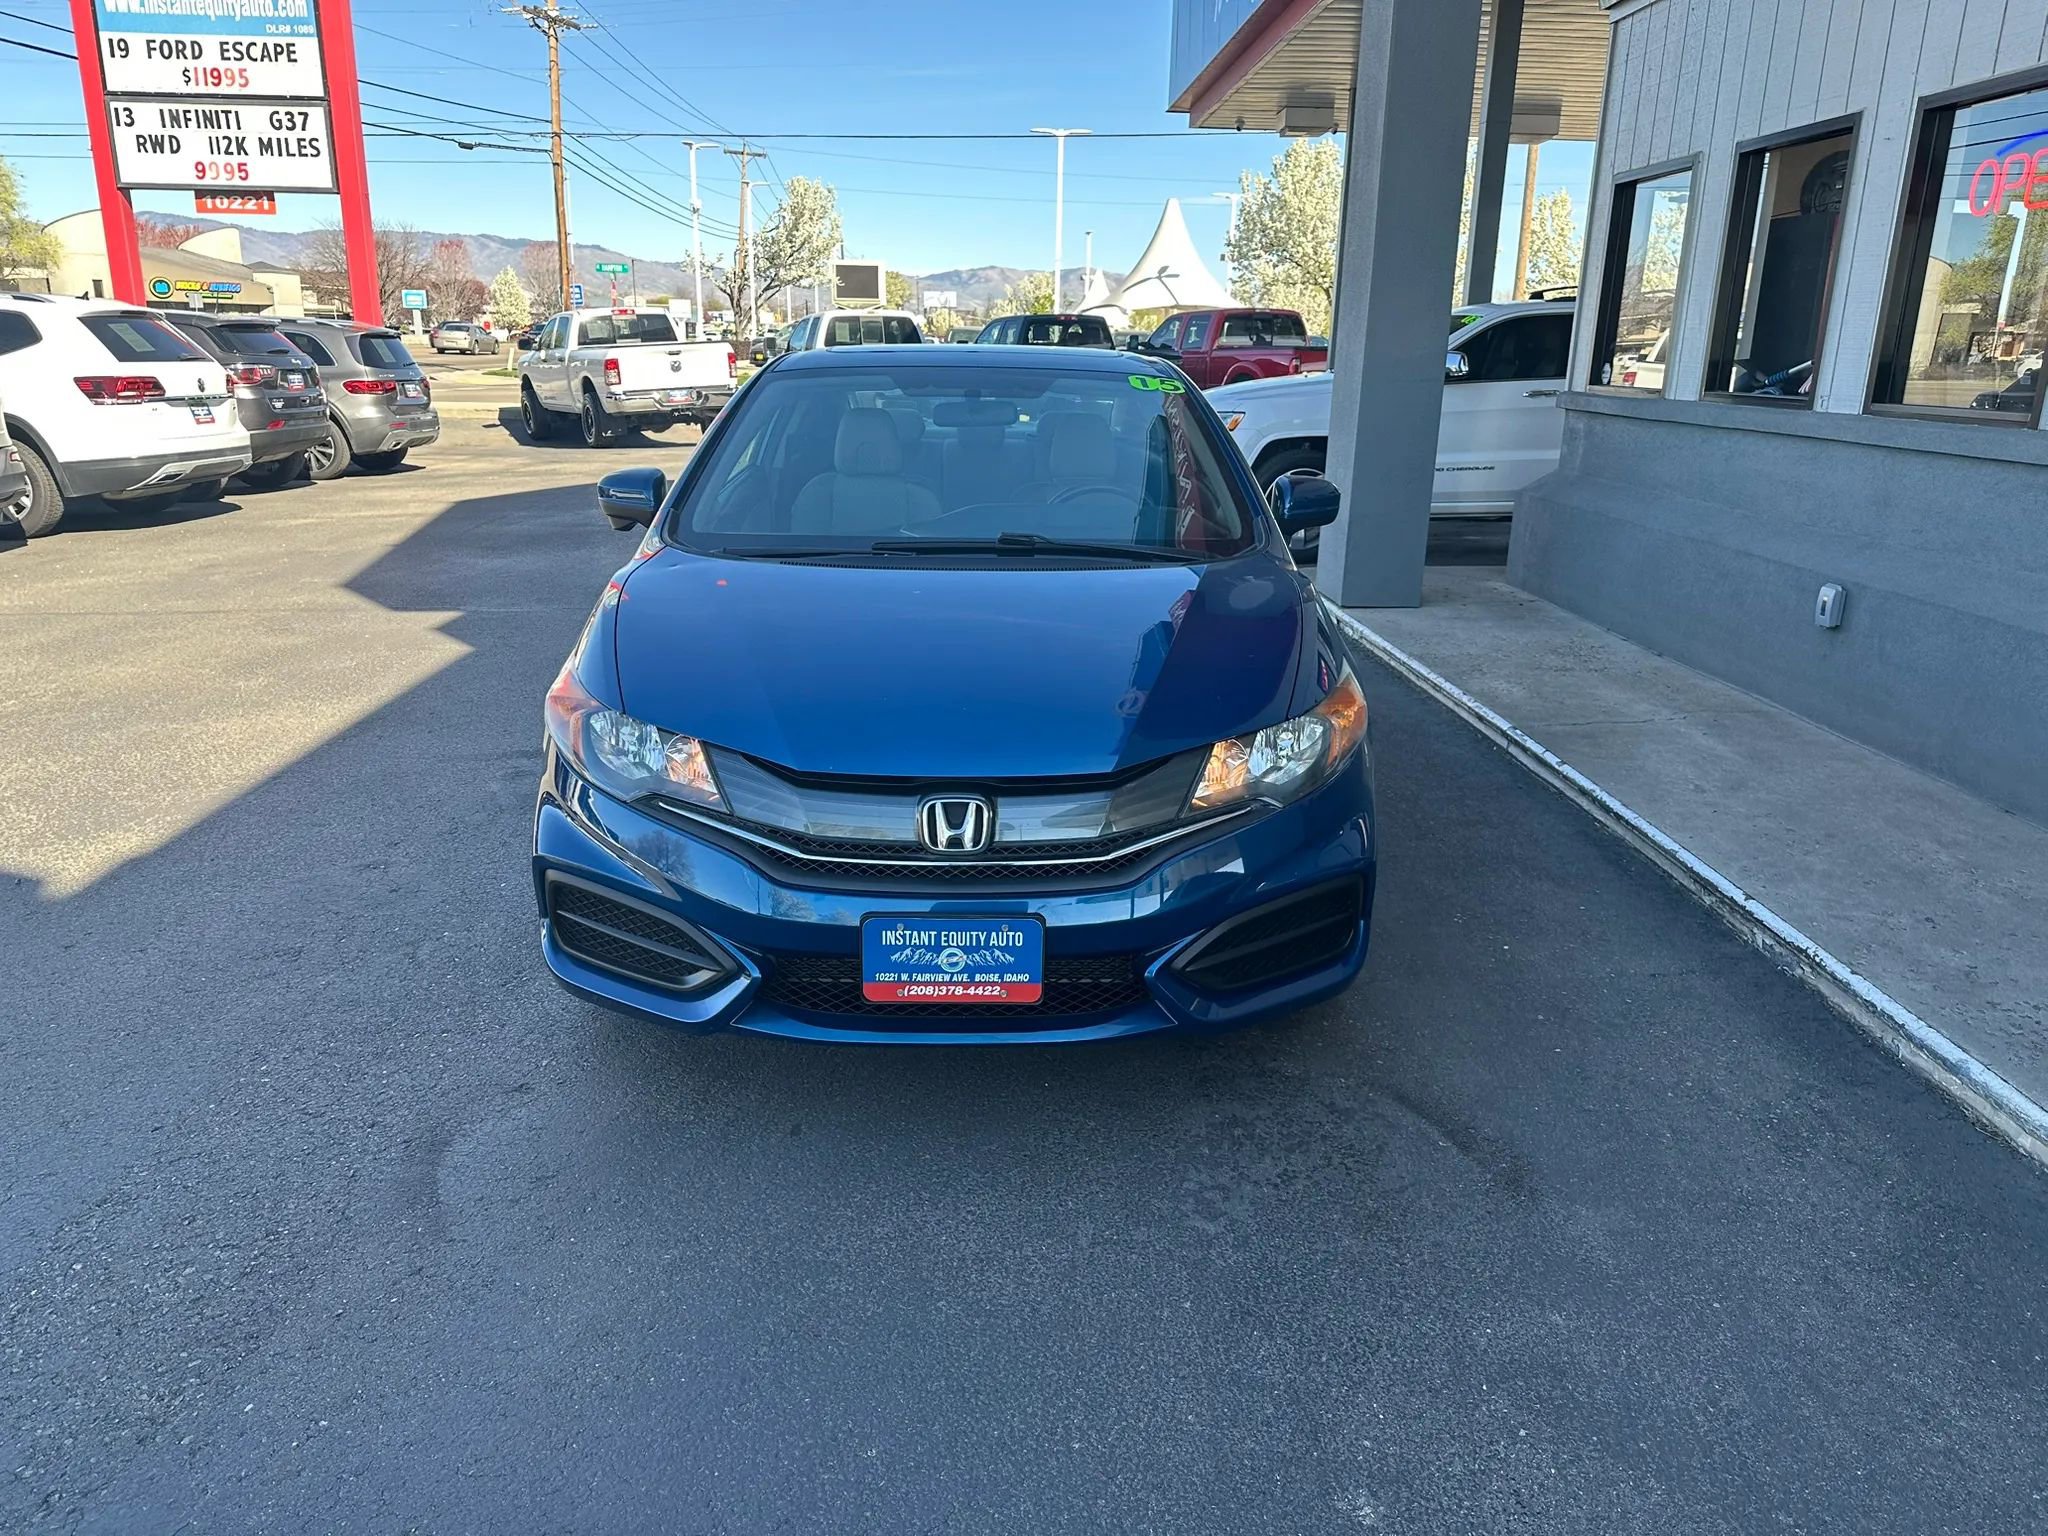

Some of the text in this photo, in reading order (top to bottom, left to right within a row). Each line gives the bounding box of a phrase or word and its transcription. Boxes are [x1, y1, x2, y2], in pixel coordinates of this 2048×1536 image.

[108, 38, 298, 63] 19 FORD ESCAPE
[182, 66, 250, 88] $11995
[113, 107, 309, 131] 13 INFINITI G37
[136, 134, 321, 157] RWD 112K MILES
[202, 195, 270, 211] 10221
[1135, 376, 1182, 391] 15
[881, 930, 1023, 947] INSTANT EQUITY AUTO
[875, 973, 1029, 983] 10221 W. FAIRVIEW AVE. BOISE, IDAHO
[904, 985, 1000, 997] (208)378-4422
